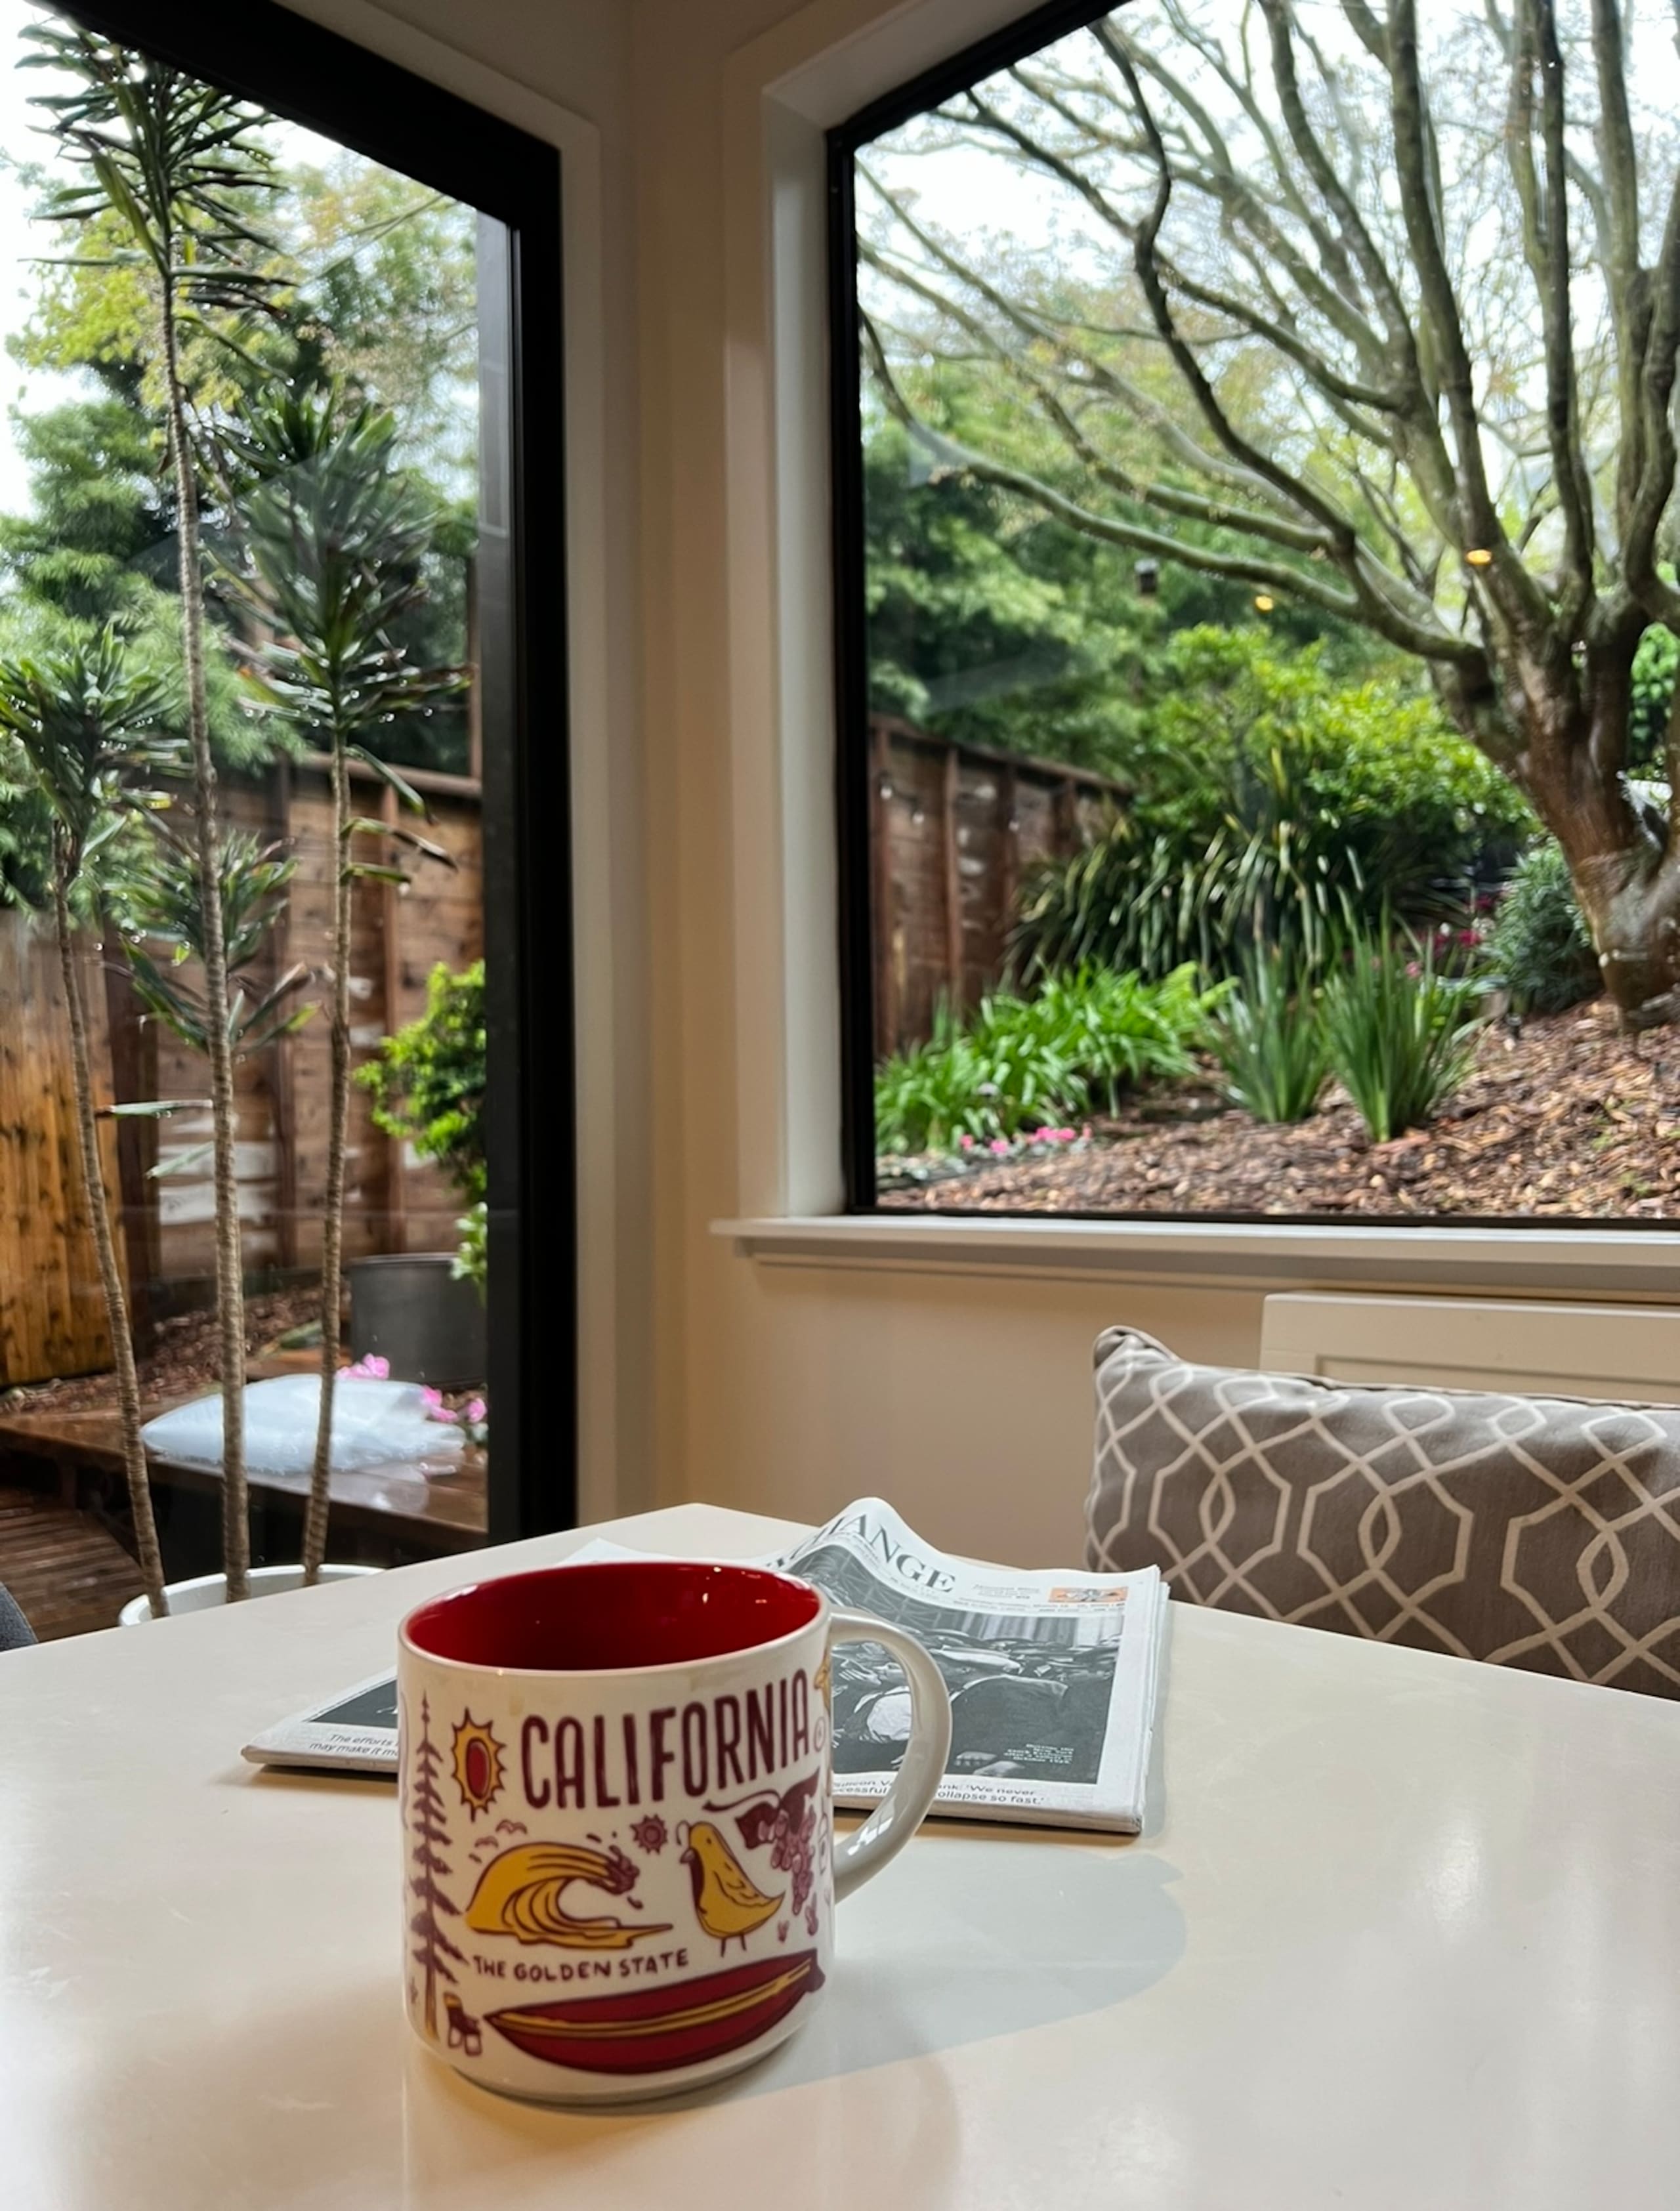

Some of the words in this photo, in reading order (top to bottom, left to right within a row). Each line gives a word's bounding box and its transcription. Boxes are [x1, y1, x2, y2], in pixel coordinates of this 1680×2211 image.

[330, 1733, 352, 1743] The
[352, 1737, 394, 1747] efforts
[520, 1668, 810, 1809] CALIFORNIA
[309, 1742, 337, 1752] may
[337, 1745, 370, 1754] make
[937, 1790, 987, 1801] ollapse
[996, 1788, 1035, 1797] never
[472, 1954, 507, 1978] THE
[513, 1960, 612, 1983] GOLDEN
[618, 1947, 689, 1977] STATE
